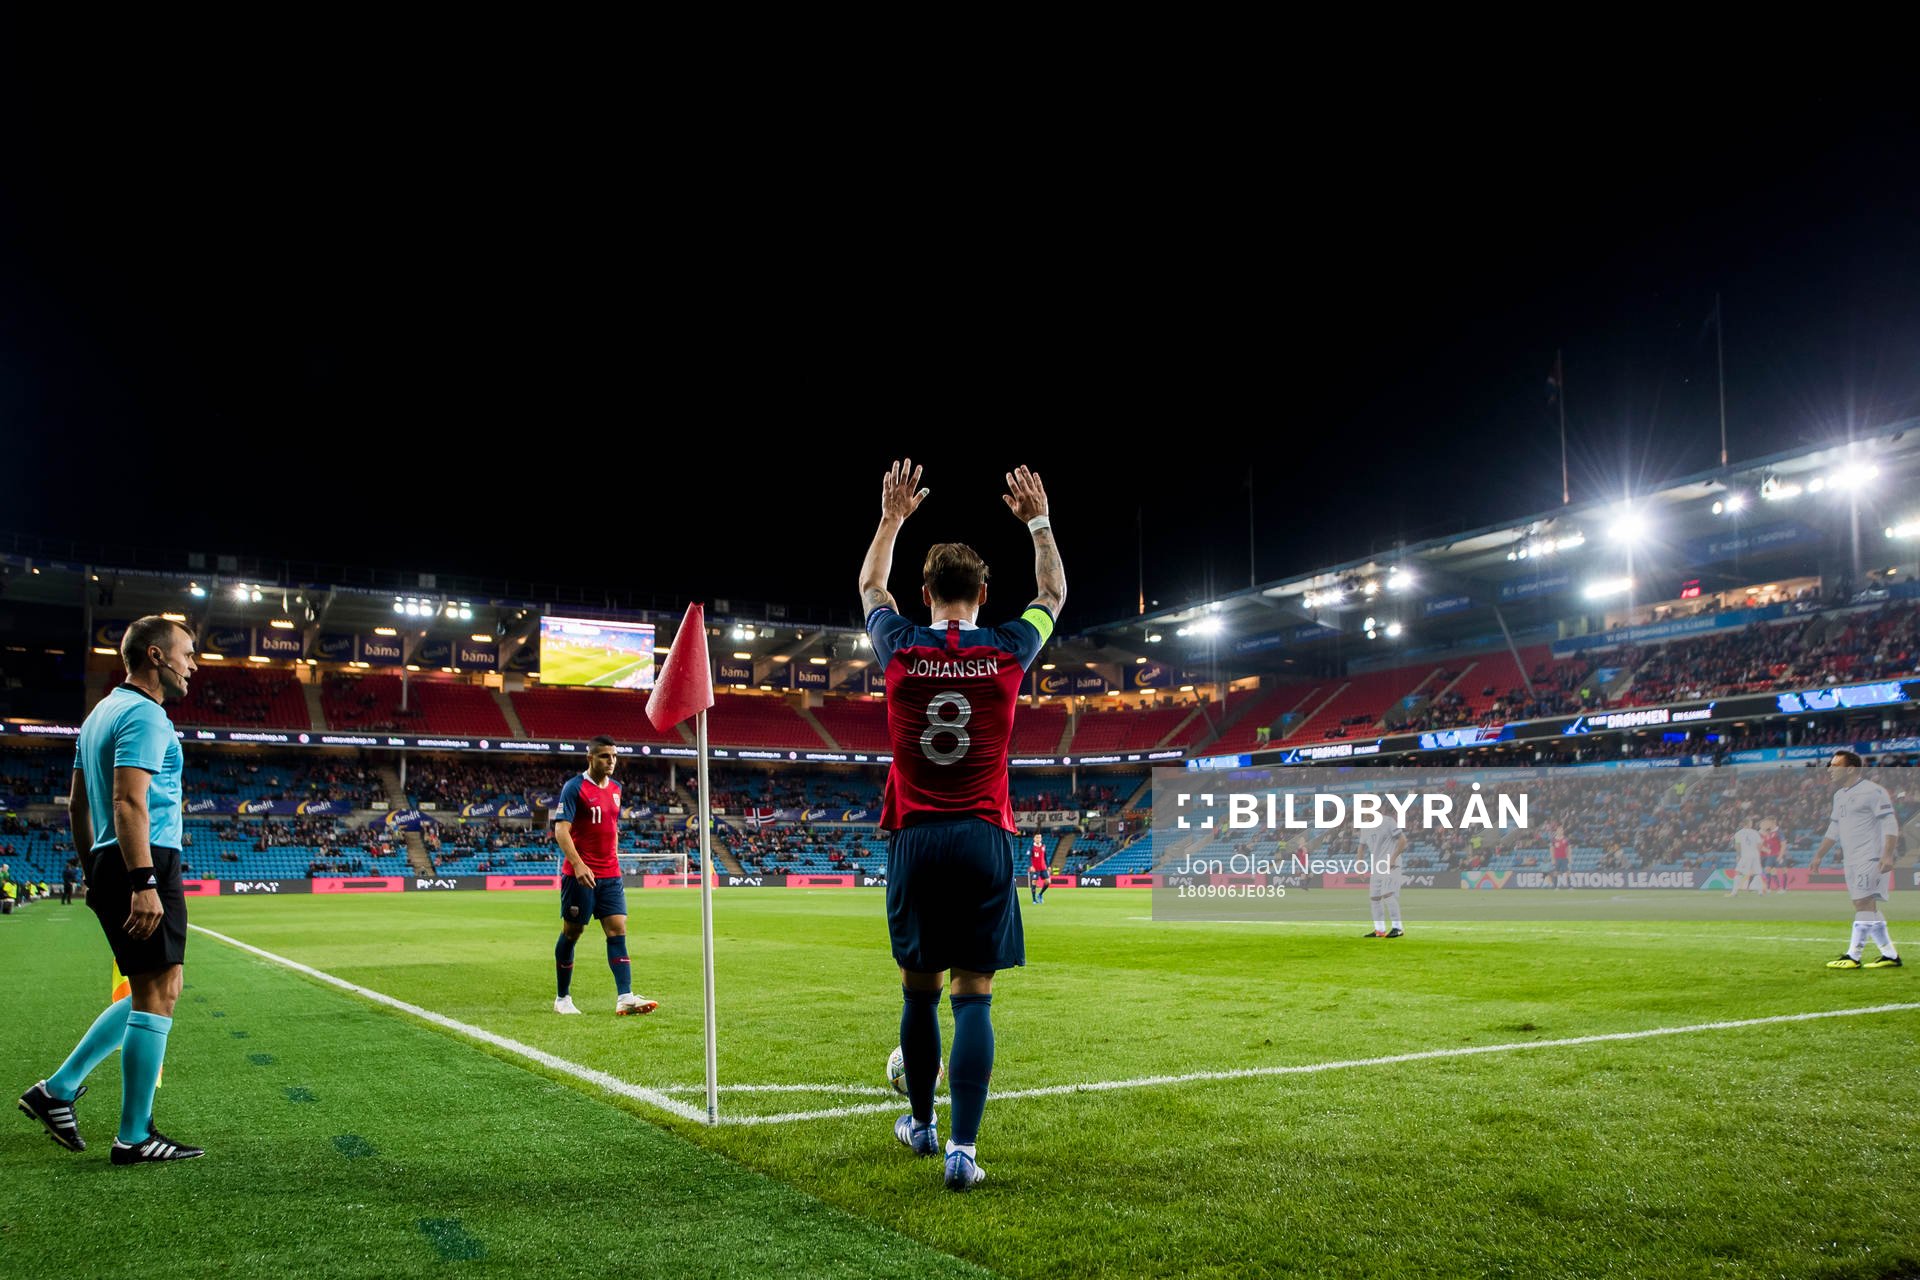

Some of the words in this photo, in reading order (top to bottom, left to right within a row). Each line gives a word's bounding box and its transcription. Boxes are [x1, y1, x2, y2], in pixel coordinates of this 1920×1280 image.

[907, 657, 998, 678] JOHANSEN
[872, 675, 886, 686] ba
[20, 725, 81, 735] eatmovesleep.n
[920, 691, 972, 765] 8
[187, 798, 216, 813] Bendit
[248, 799, 274, 813] Bendit
[307, 800, 331, 814] Bendit
[471, 804, 494, 816] Bendit
[506, 804, 529, 816] Bendit
[395, 809, 421, 824] Bendit
[590, 806, 602, 824] 11
[1517, 873, 1553, 888] UEFA
[1627, 872, 1694, 888] LEAGUE
